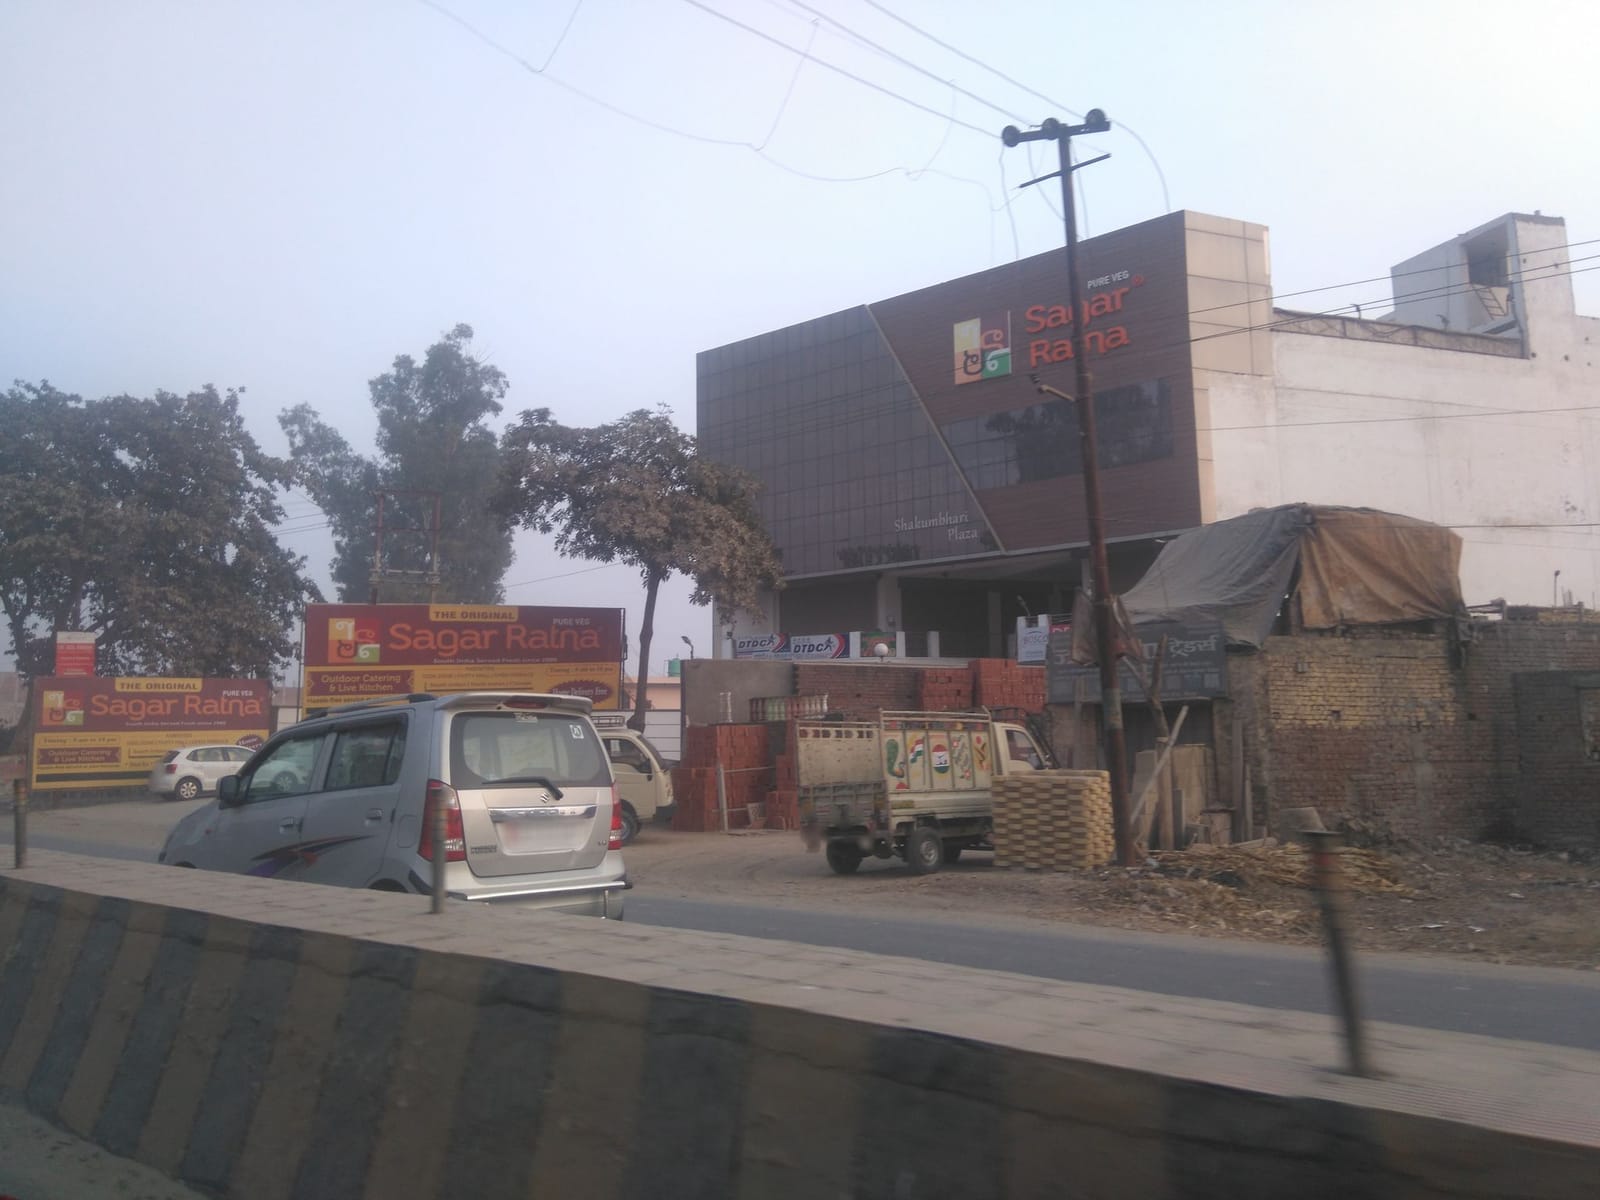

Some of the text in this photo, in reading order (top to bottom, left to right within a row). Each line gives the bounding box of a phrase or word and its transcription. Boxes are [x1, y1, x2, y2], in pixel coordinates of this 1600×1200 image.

[1087, 270, 1129, 289] PURE VEG
[1029, 324, 1131, 368] Rana
[948, 526, 978, 541] Plaza
[433, 611, 515, 619] THE ORIGINAL
[388, 623, 601, 657] Sagar Ratna
[738, 639, 769, 649] DTDC
[793, 643, 824, 653] DTDC
[321, 674, 401, 683] Outdoor Catering
[120, 682, 198, 690] THE ORIGINAL
[329, 683, 393, 692] & Live Kitchen
[222, 689, 240, 697] PURE
[91, 694, 262, 721] Sagar Ratna
